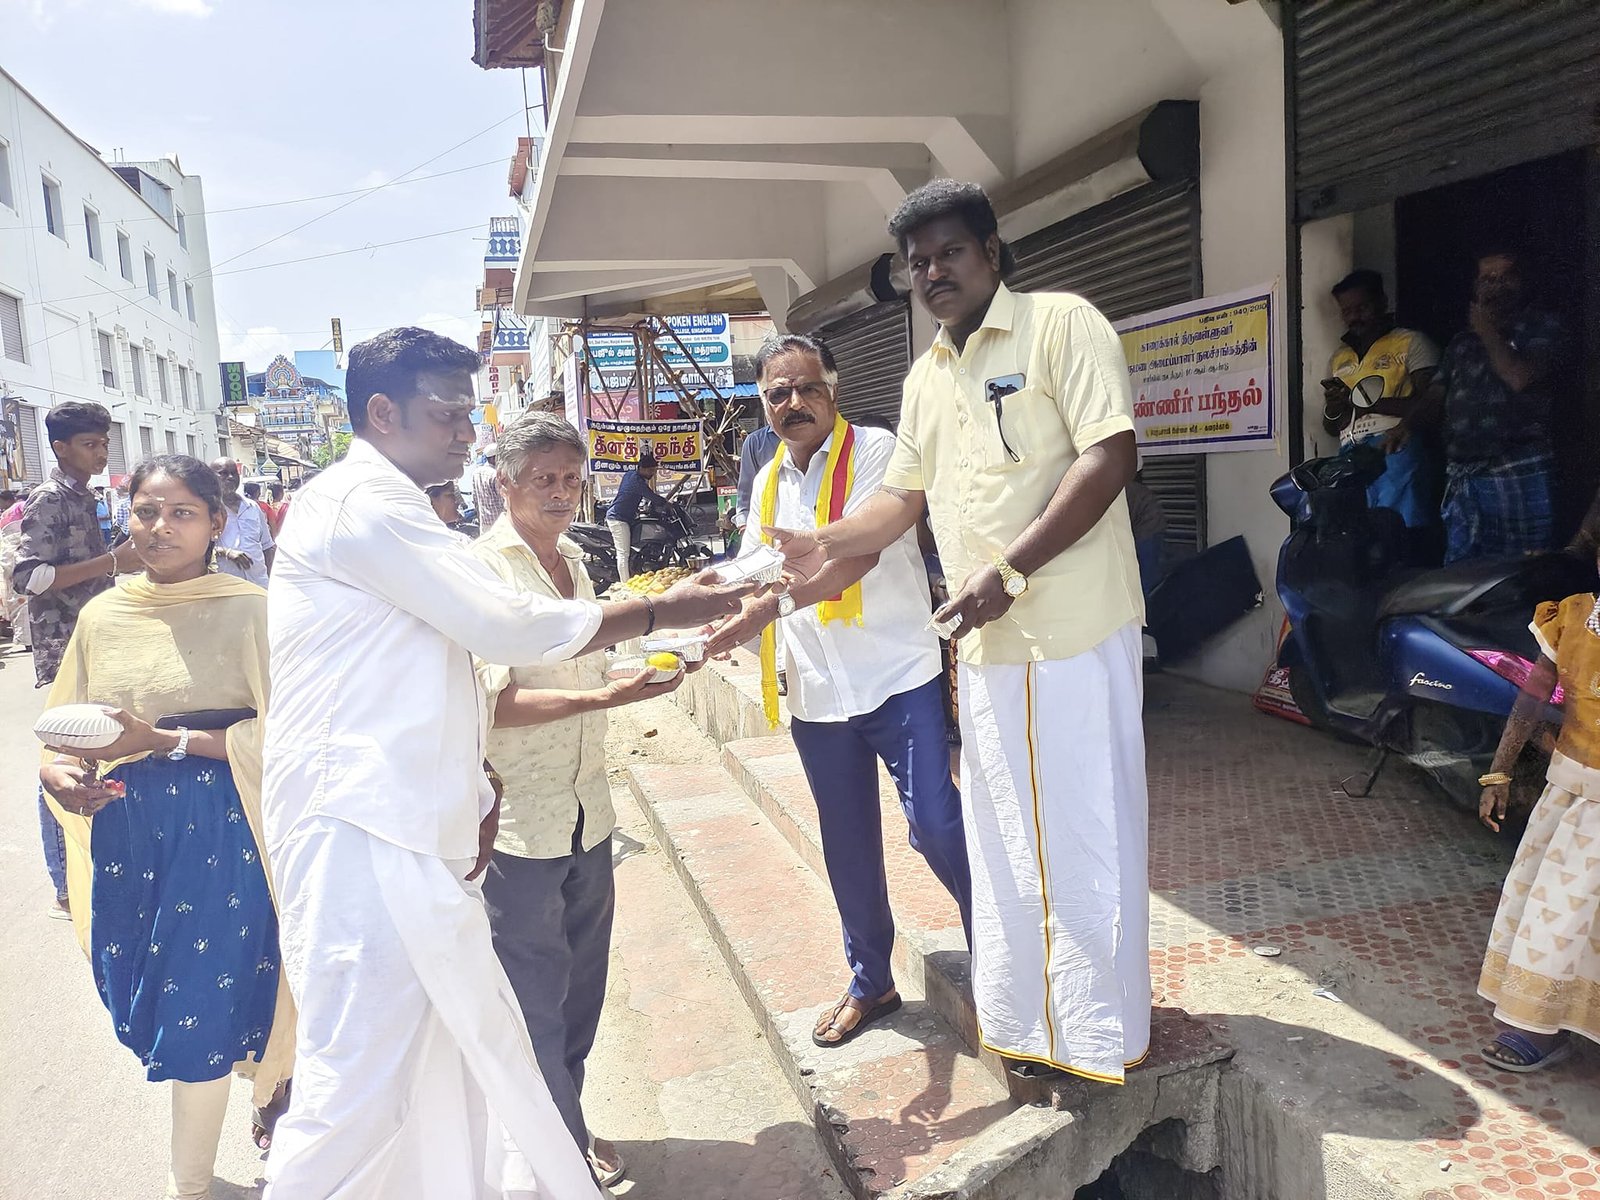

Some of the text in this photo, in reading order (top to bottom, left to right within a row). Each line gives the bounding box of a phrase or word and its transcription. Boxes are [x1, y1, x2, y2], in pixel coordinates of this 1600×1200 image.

[662, 315, 691, 327] POKEN
[692, 315, 722, 327] ENGLISH
[1181, 321, 1233, 345] திருவள்ளுவர்
[1149, 350, 1195, 369] அமைப்பாளர்
[1196, 337, 1257, 364] நலச்சங்கத்தின்
[227, 363, 243, 401] MOON
[1198, 377, 1262, 419] பந்தல்
[658, 424, 671, 432] ஒரே
[672, 423, 696, 432] நாளிதழ்
[594, 435, 696, 459] தினத் தந்தி
[594, 461, 621, 471] தினமும்
[1409, 672, 1452, 690] fascino
